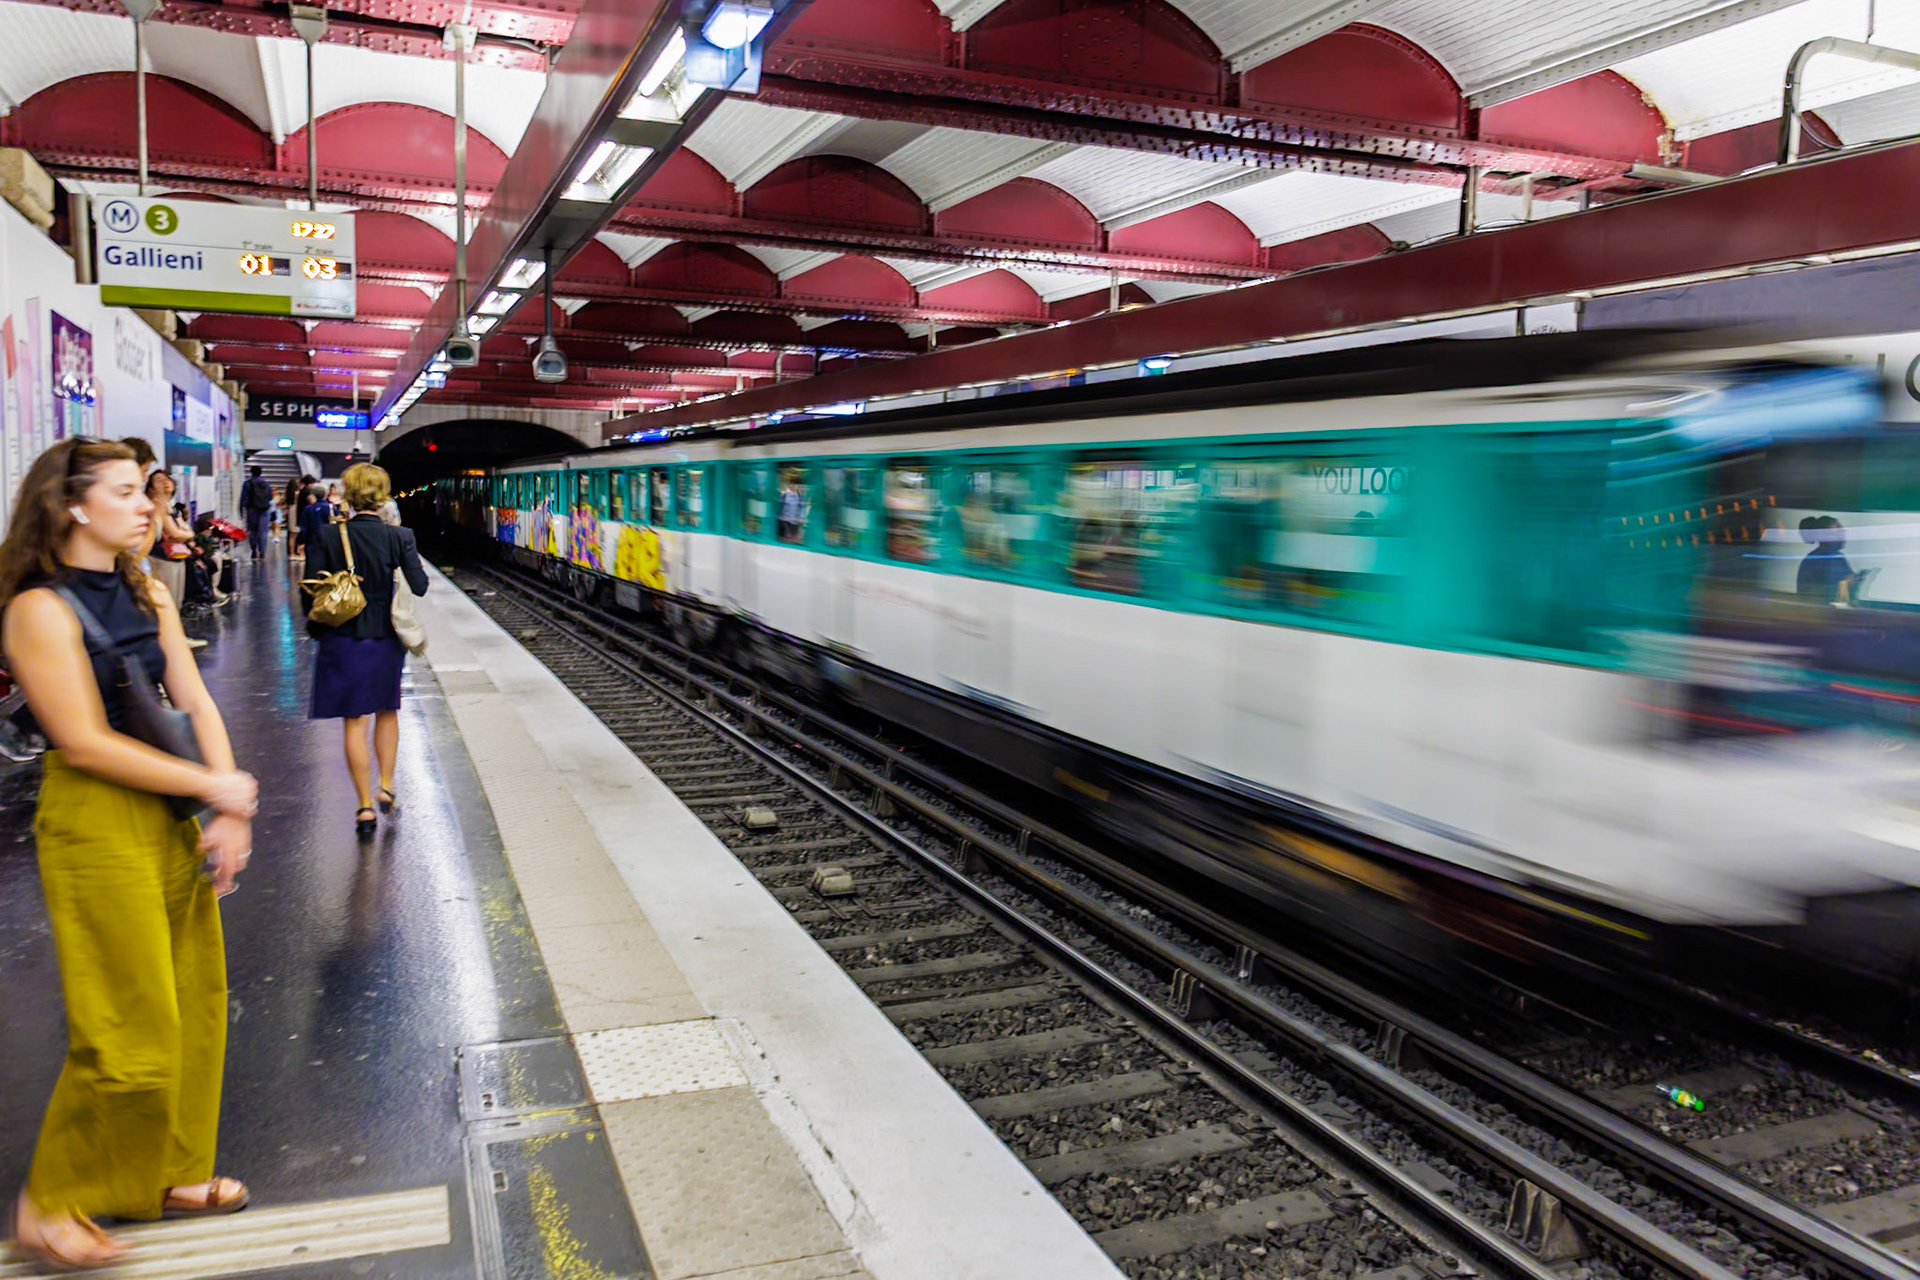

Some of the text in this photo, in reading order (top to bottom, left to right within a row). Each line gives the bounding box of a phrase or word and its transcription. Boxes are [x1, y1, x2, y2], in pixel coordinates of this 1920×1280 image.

[153, 210, 171, 231] 3
[104, 246, 203, 271] Gallieni
[239, 253, 273, 277] 01
[301, 256, 337, 280] 03
[1313, 466, 1411, 494] YOU LOO
